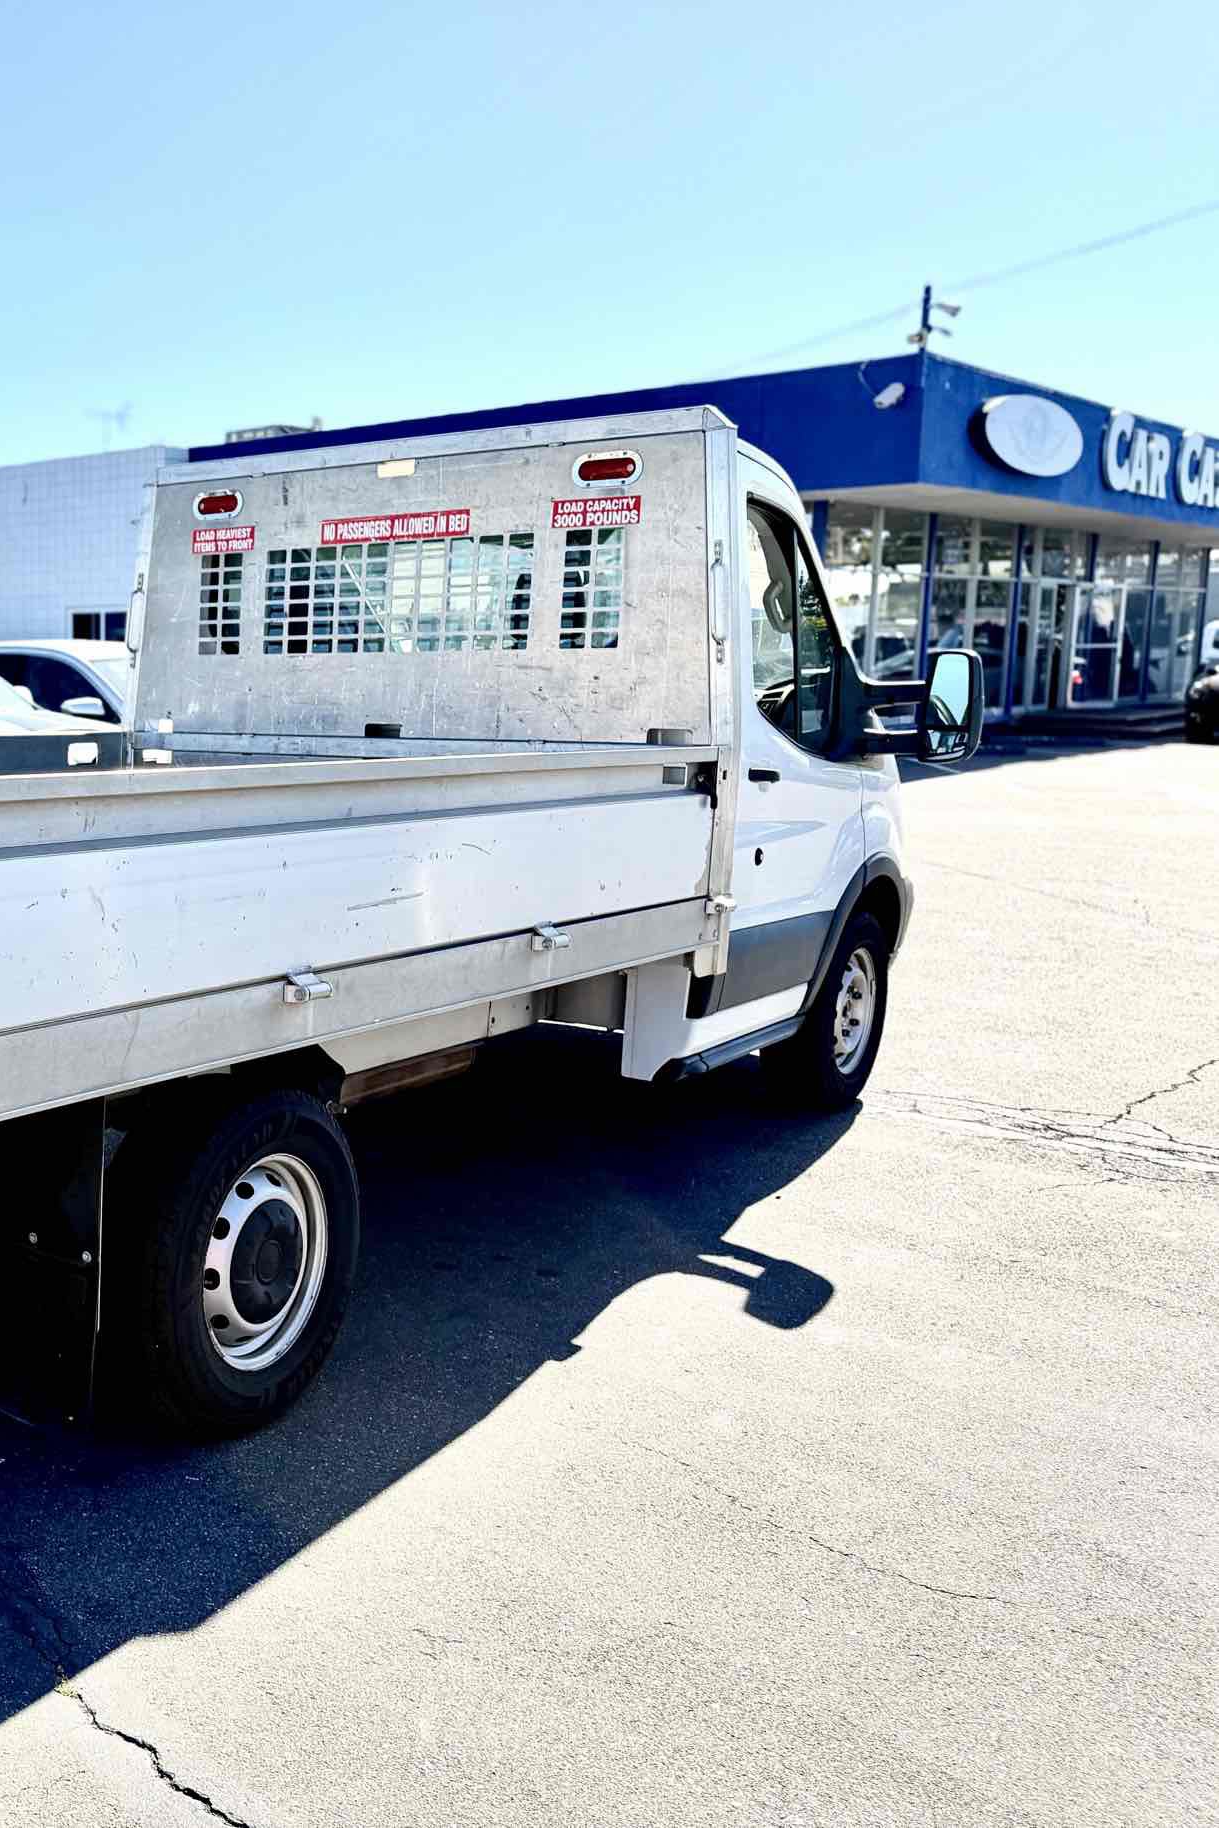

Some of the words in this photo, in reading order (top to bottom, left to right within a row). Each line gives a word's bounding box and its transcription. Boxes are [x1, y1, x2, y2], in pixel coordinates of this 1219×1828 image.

[1105, 410, 1171, 500] CAR
[558, 501, 584, 514] LOAD
[586, 497, 636, 512] CAPACITY
[323, 523, 336, 541] NO
[337, 519, 392, 541] PASSENGERS
[392, 516, 435, 537] ALLOWED
[435, 514, 447, 533] IN
[448, 513, 468, 532] BED
[554, 513, 583, 528] 3000
[586, 509, 639, 526] POUNDS
[196, 530, 216, 541] LOAD
[216, 527, 252, 541] HEAVIEST
[194, 540, 216, 553] ITEMS
[217, 540, 228, 551] TO
[228, 538, 254, 551] FRONT
